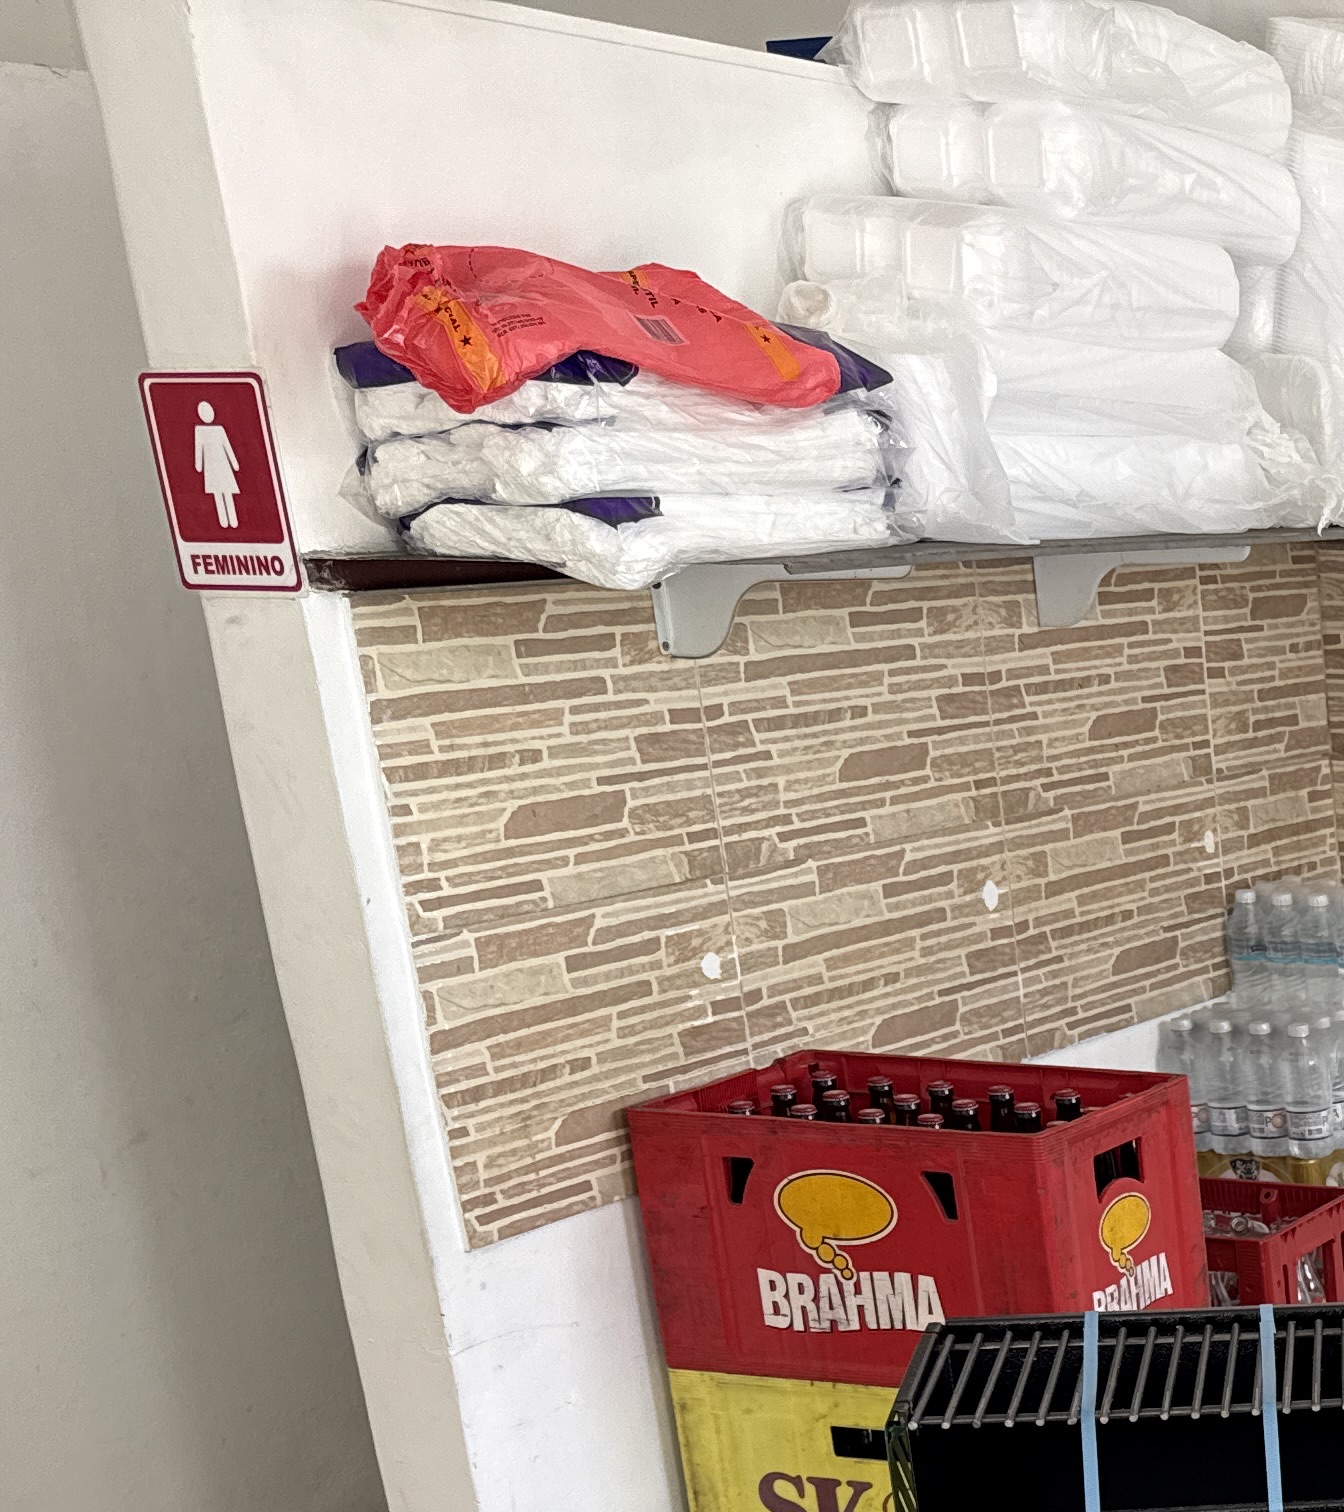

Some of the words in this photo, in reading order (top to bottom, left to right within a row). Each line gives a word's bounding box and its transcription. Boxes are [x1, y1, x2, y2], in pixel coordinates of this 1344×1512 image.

[190, 554, 285, 576] FEMININO
[757, 1267, 946, 1333] BRAHMA
[1092, 1252, 1174, 1313] BRAHMA
